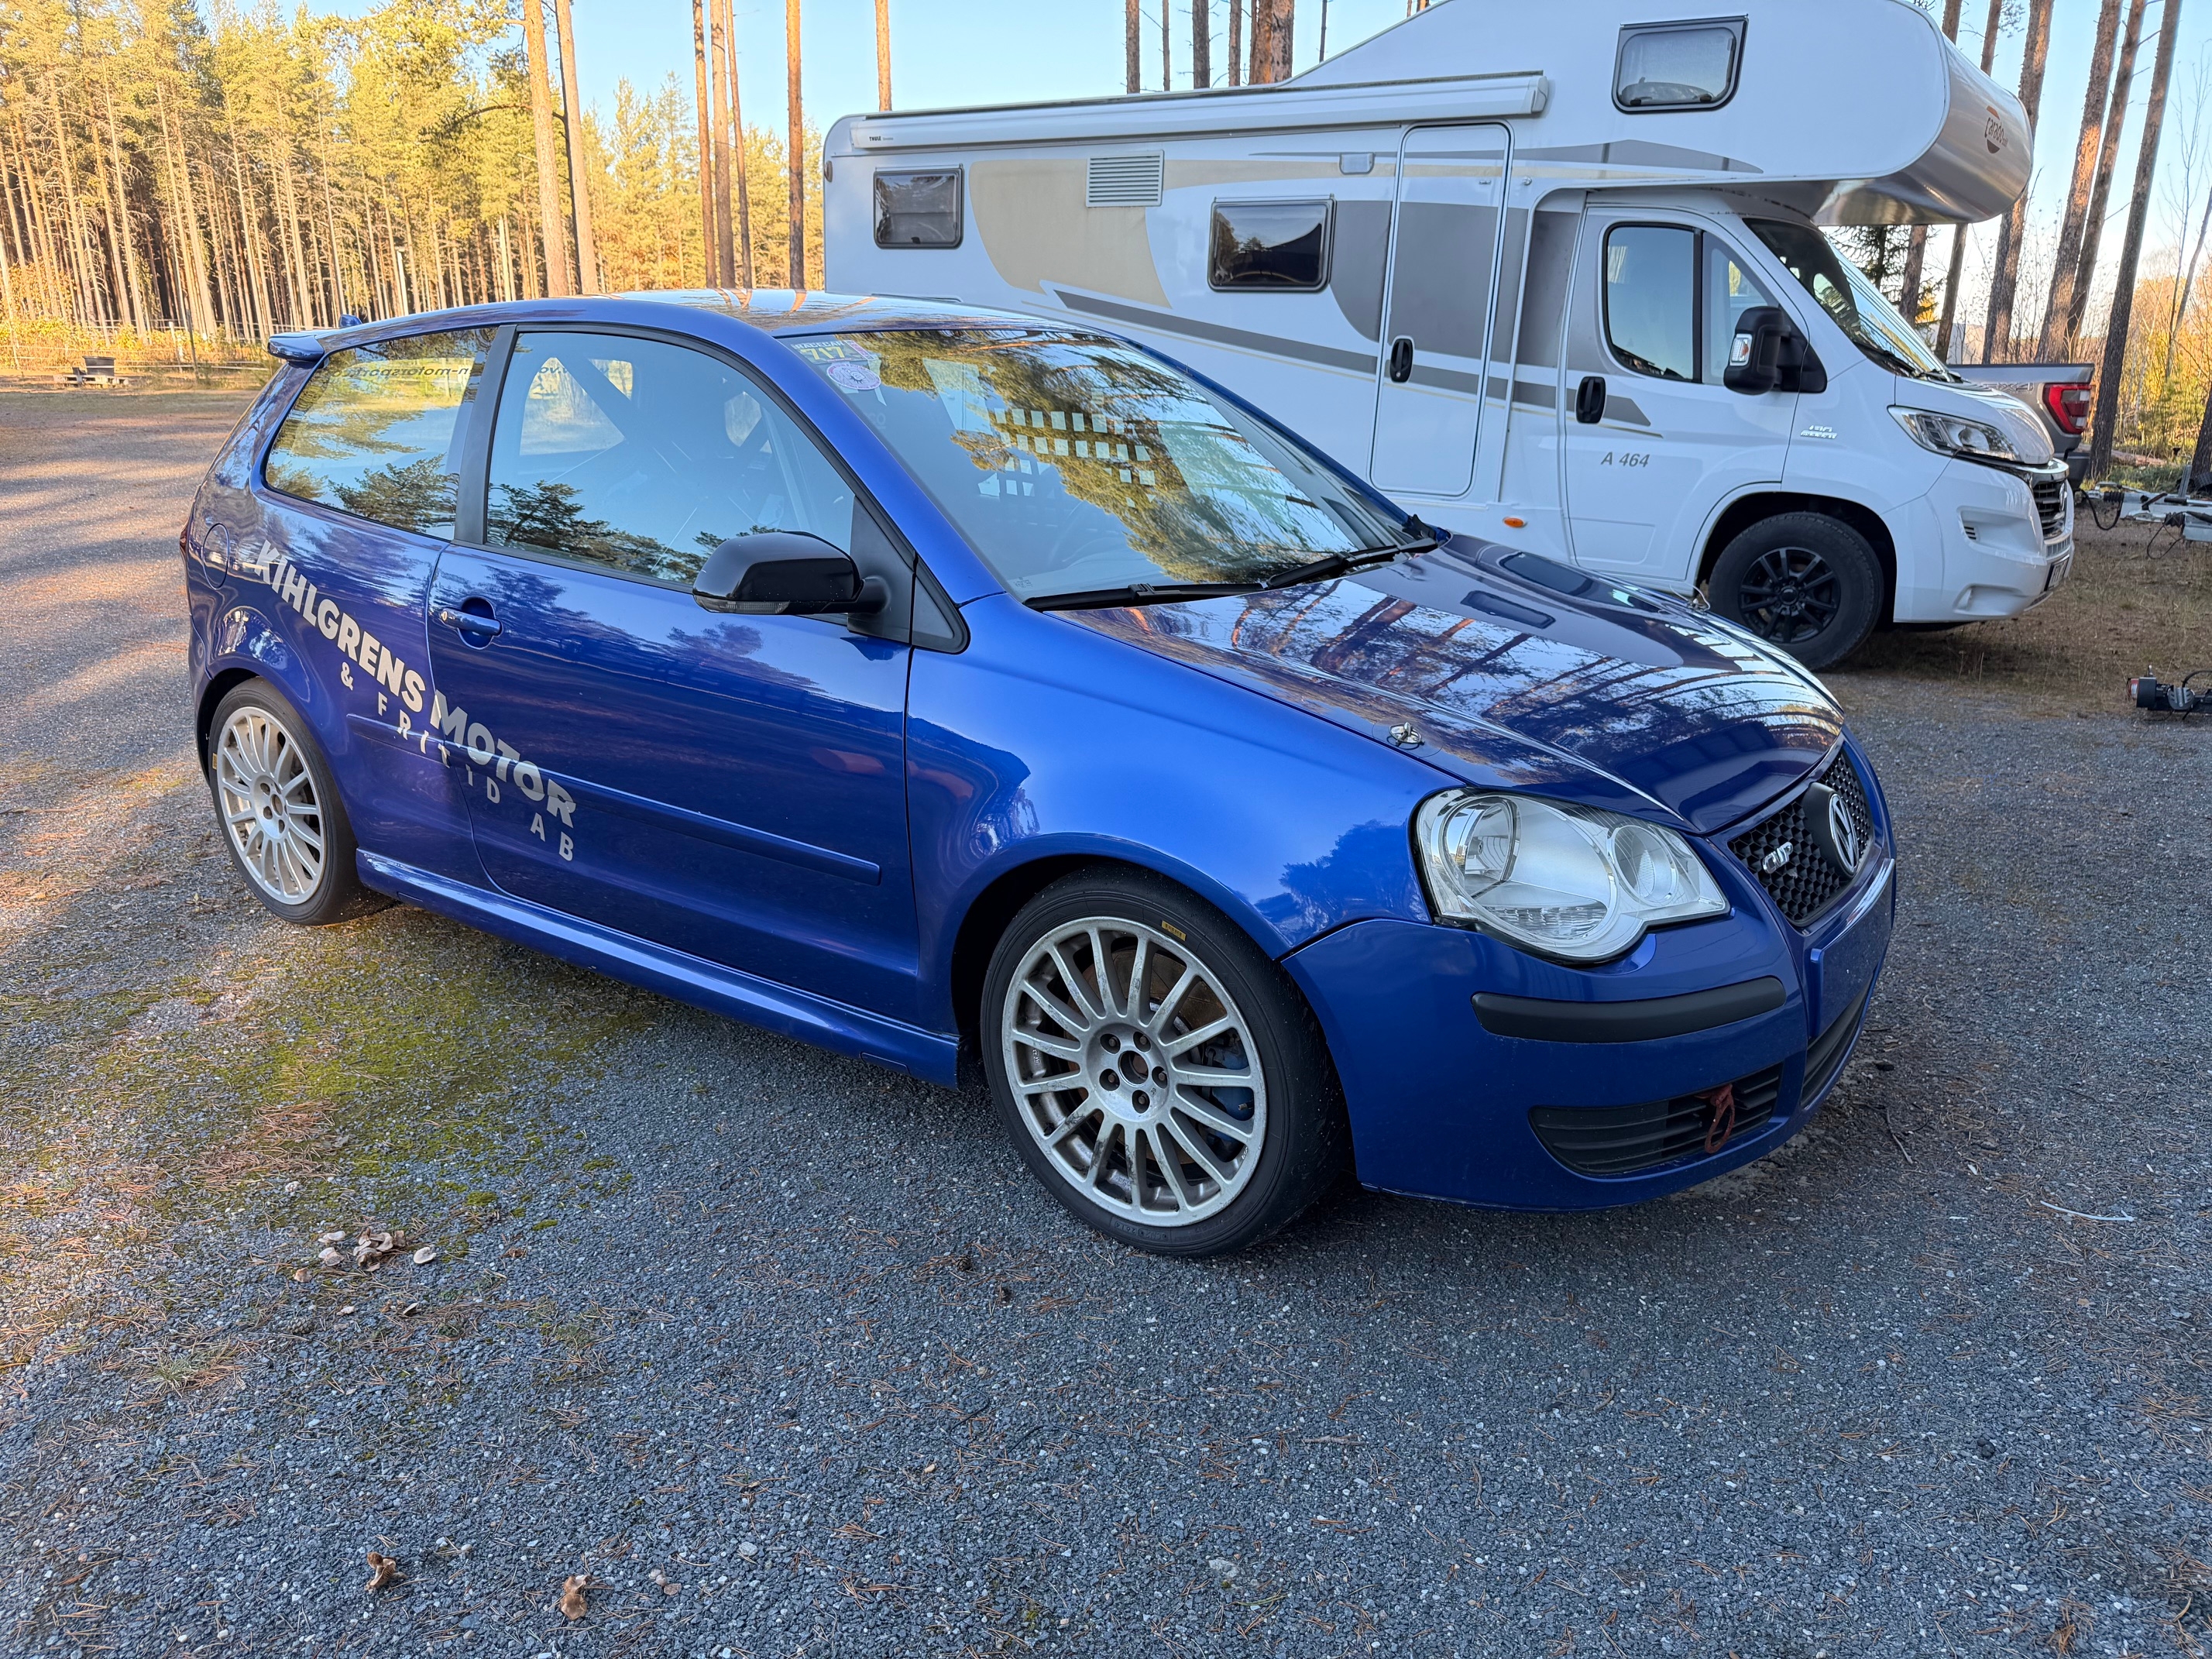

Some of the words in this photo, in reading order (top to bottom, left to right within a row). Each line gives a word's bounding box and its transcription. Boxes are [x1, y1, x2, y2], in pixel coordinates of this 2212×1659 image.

[799, 346, 845, 360] 717
[1600, 451, 1613, 466] A
[1619, 452, 1650, 469] 464
[253, 539, 426, 713] KIHLGRENS
[430, 689, 577, 829] MOTOR
[340, 661, 354, 691] &
[377, 691, 501, 805] FRITID
[530, 812, 574, 862] AB
